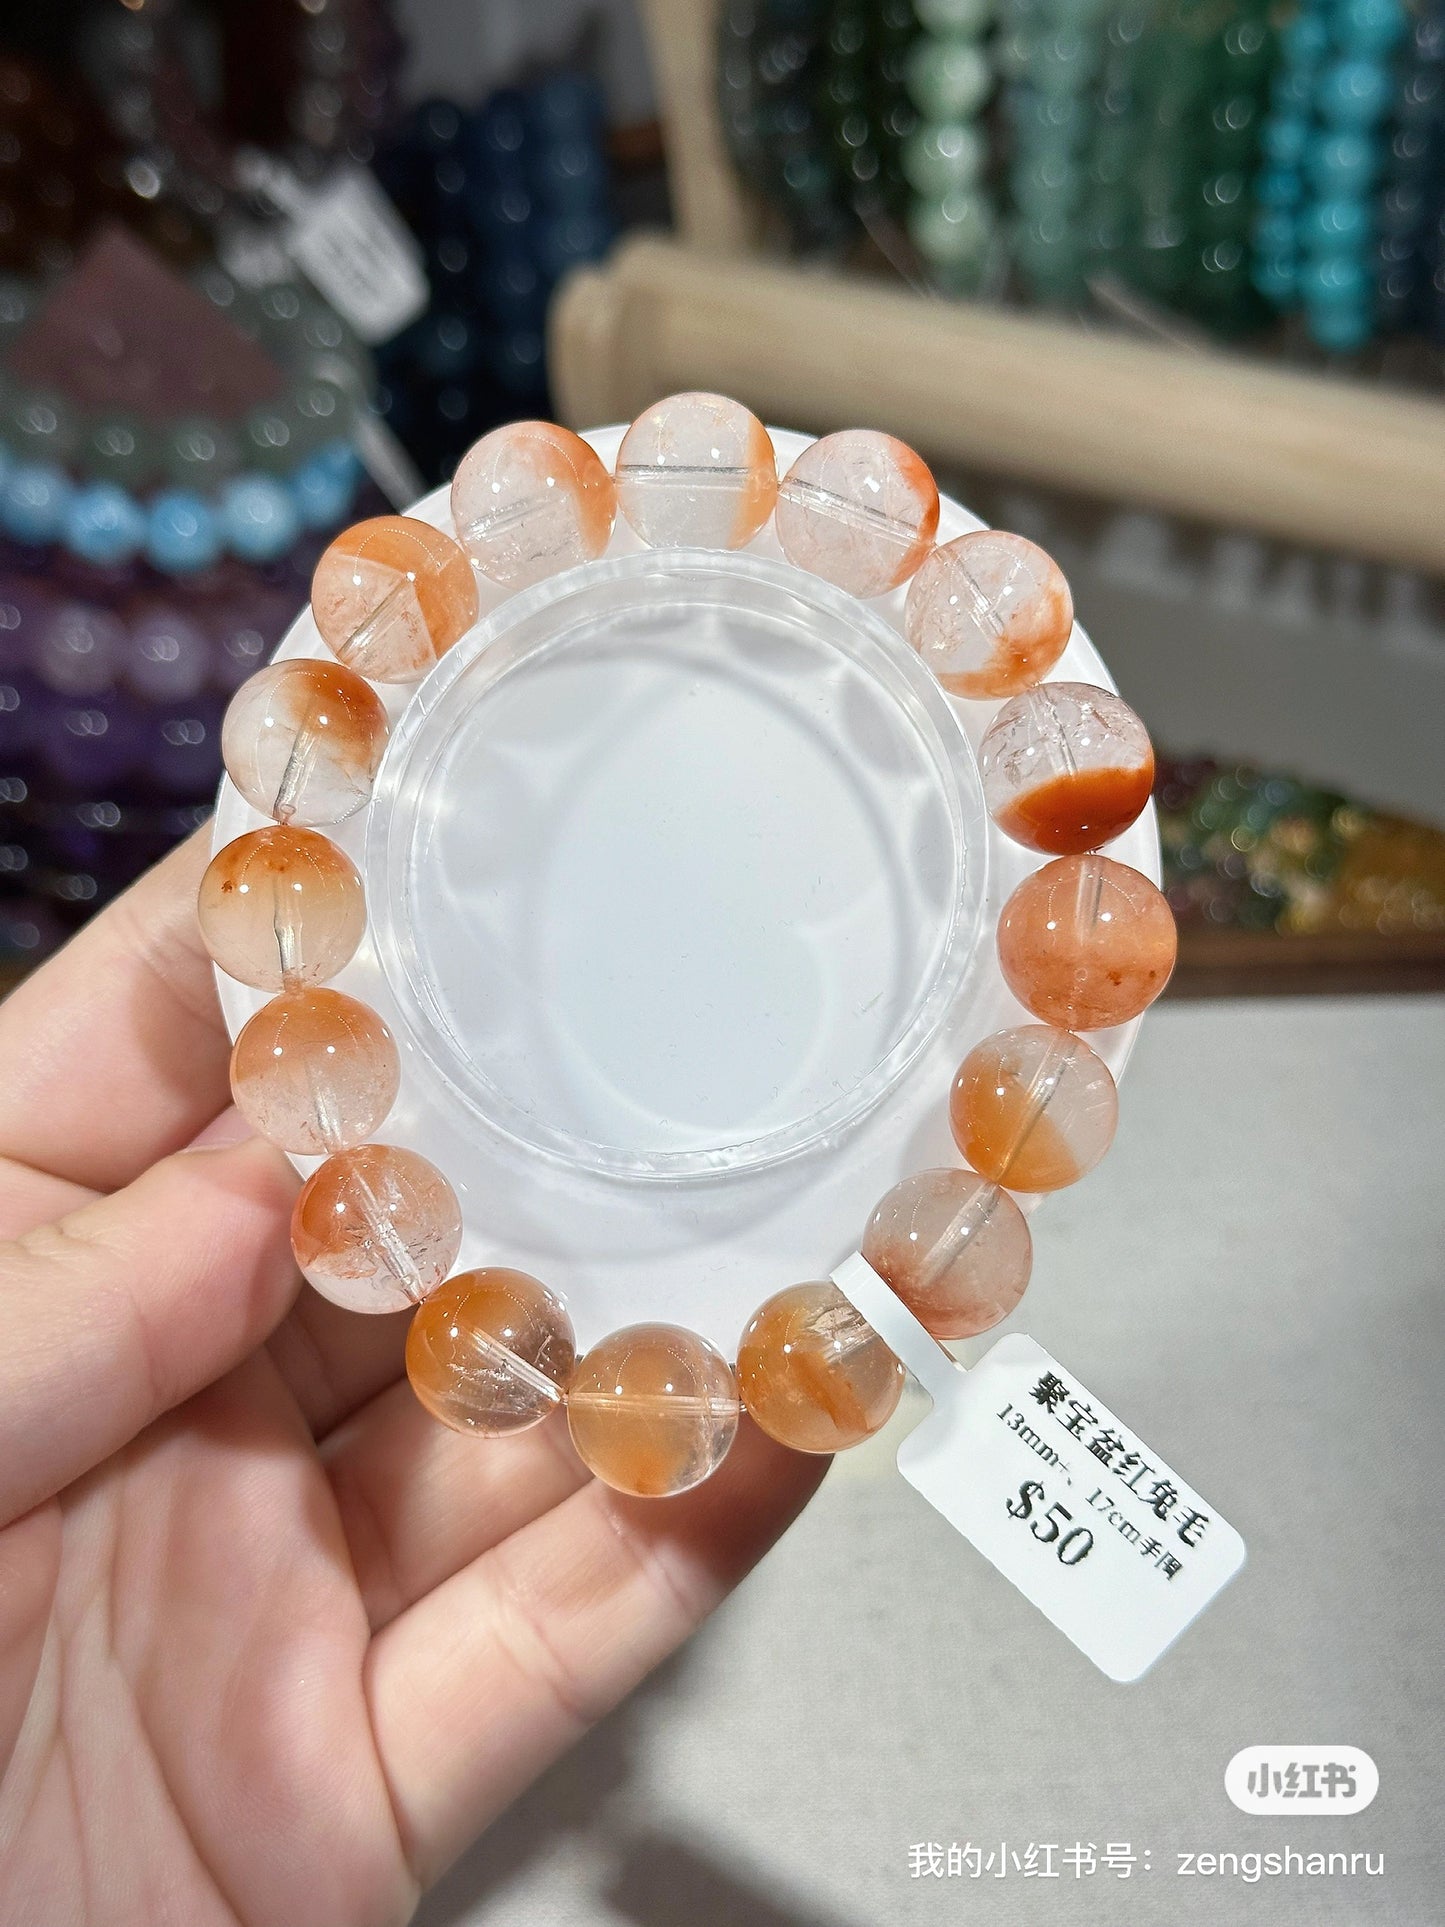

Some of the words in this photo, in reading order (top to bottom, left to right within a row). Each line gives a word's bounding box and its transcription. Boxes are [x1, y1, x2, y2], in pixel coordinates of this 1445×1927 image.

[1006, 1480, 1094, 1565] $50
[1029, 1371, 1209, 1548] 聚宝盆红兔毛
